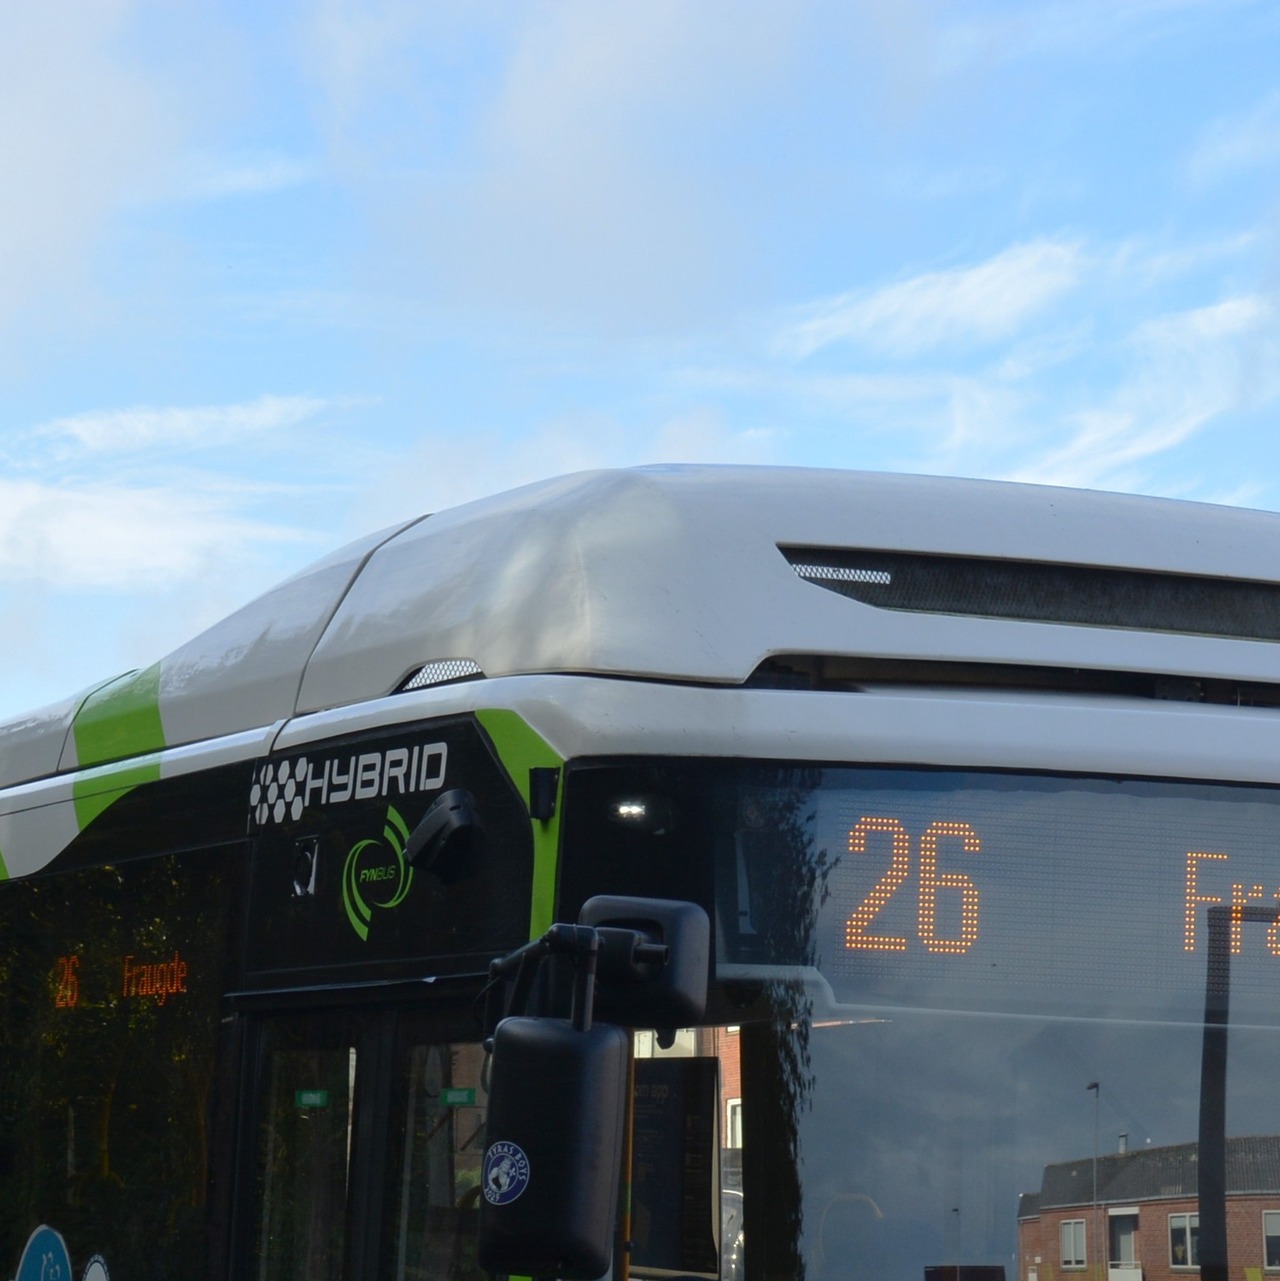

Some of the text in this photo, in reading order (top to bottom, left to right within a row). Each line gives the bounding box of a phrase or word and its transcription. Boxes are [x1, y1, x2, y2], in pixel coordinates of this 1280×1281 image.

[304, 741, 448, 808] HYBRID
[359, 864, 396, 884] FYNBUS
[845, 816, 981, 955] 26
[122, 949, 189, 1008] Fraugde
[488, 1144, 529, 1181] TYRAS BOYS
